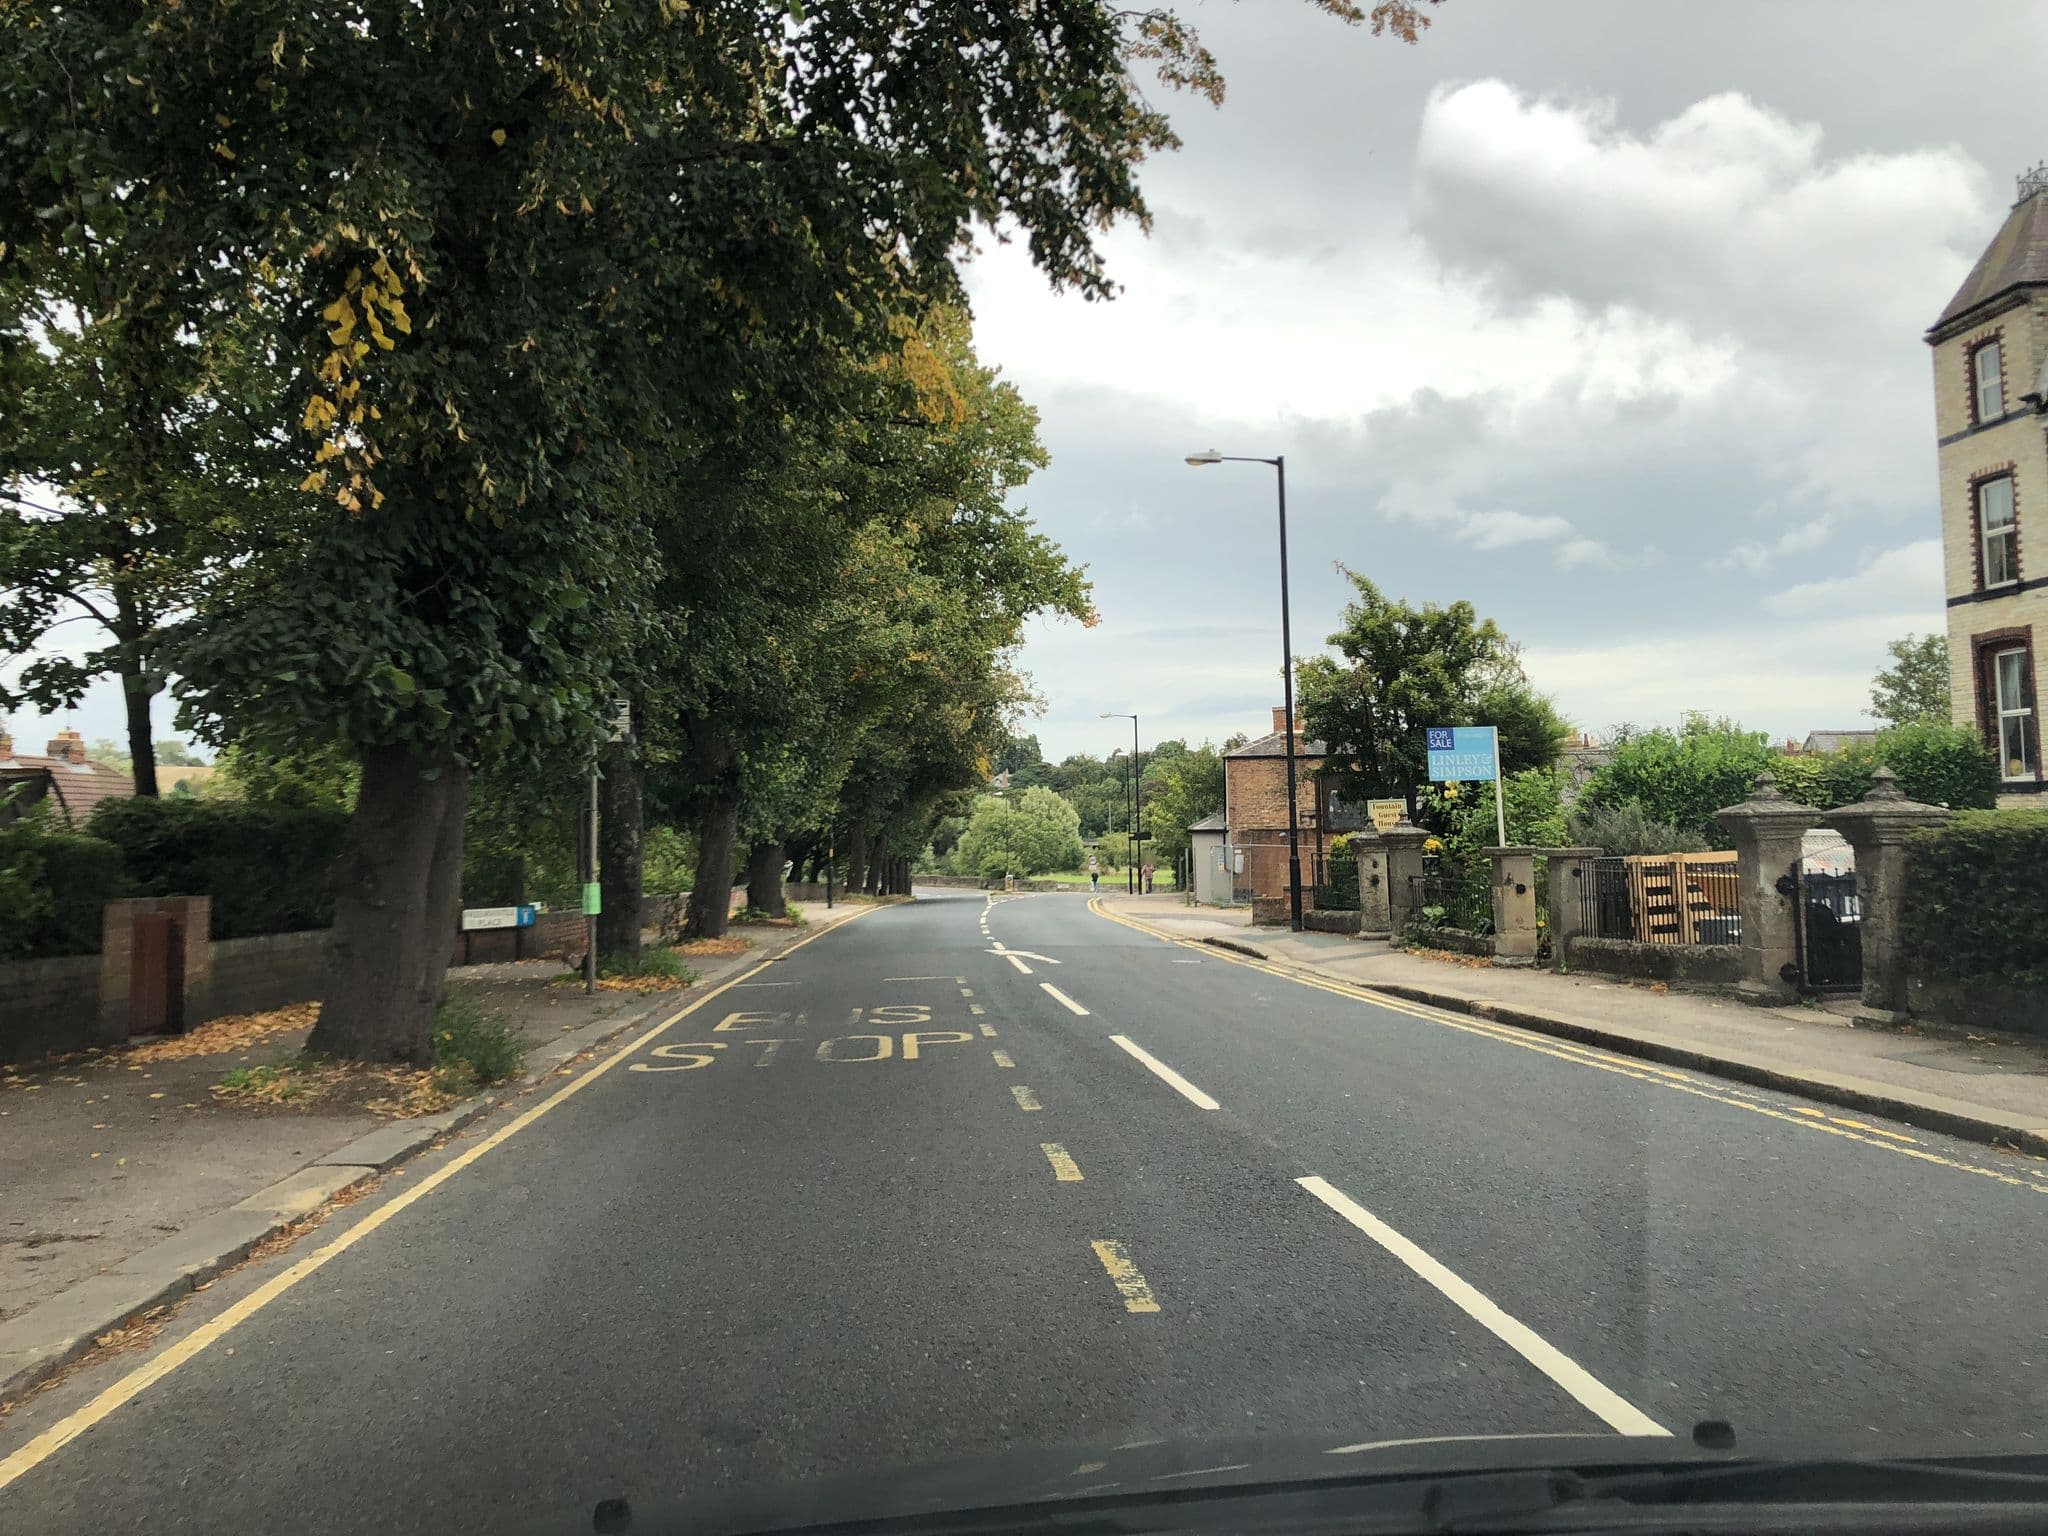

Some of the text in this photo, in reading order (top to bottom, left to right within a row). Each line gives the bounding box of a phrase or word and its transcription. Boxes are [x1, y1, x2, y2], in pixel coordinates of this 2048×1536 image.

[1429, 730, 1448, 739] FOR
[1430, 739, 1452, 748] SALE
[1431, 766, 1492, 778] SIMPSON
[628, 1031, 974, 1073] STOP
